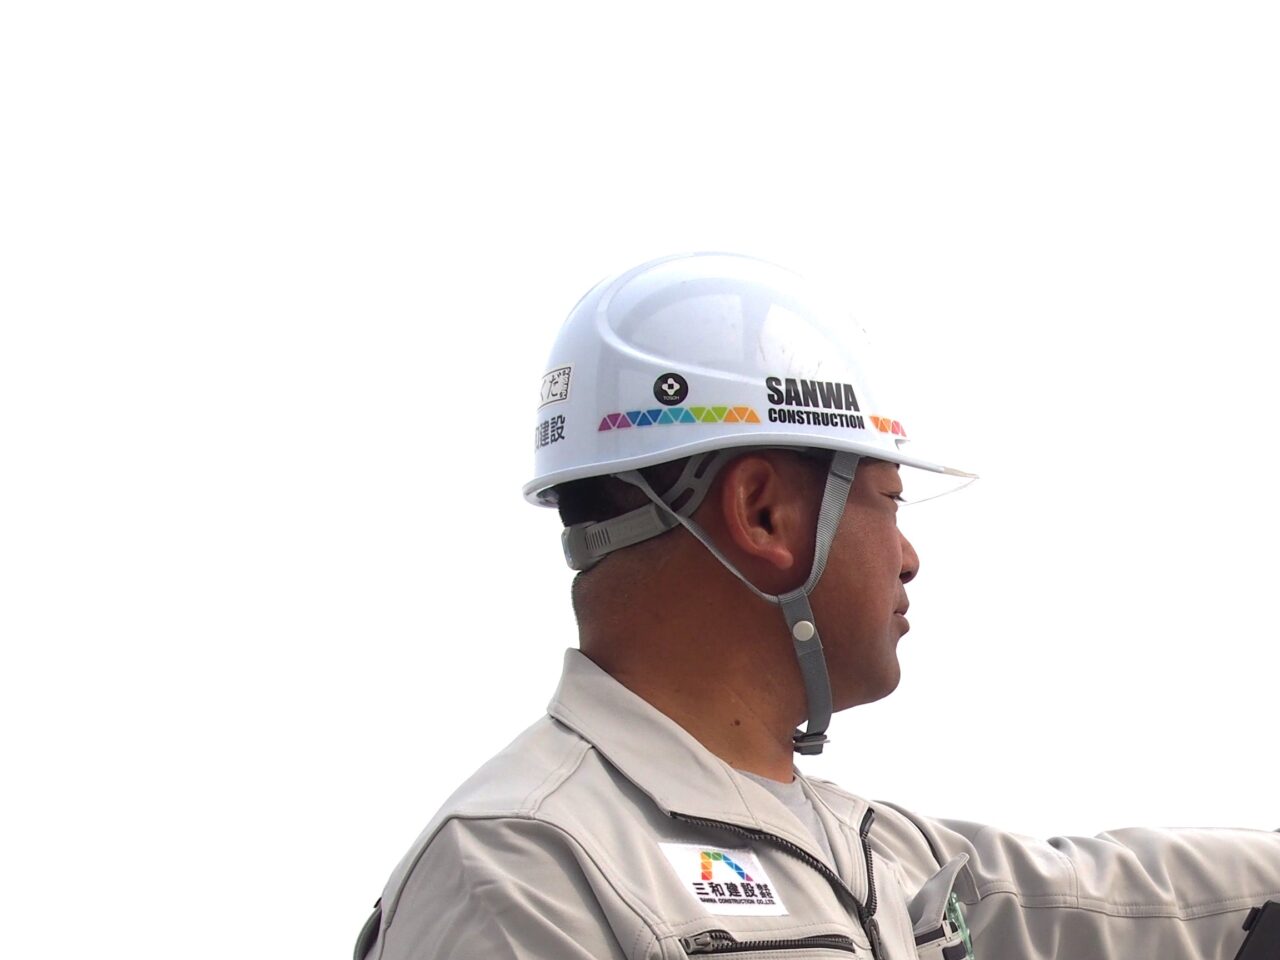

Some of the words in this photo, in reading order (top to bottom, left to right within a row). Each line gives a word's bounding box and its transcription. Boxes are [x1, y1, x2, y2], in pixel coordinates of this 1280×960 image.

[765, 376, 860, 412] SANWA
[768, 407, 865, 429] CONSTRUCTION
[692, 882, 758, 898] 三和建設
